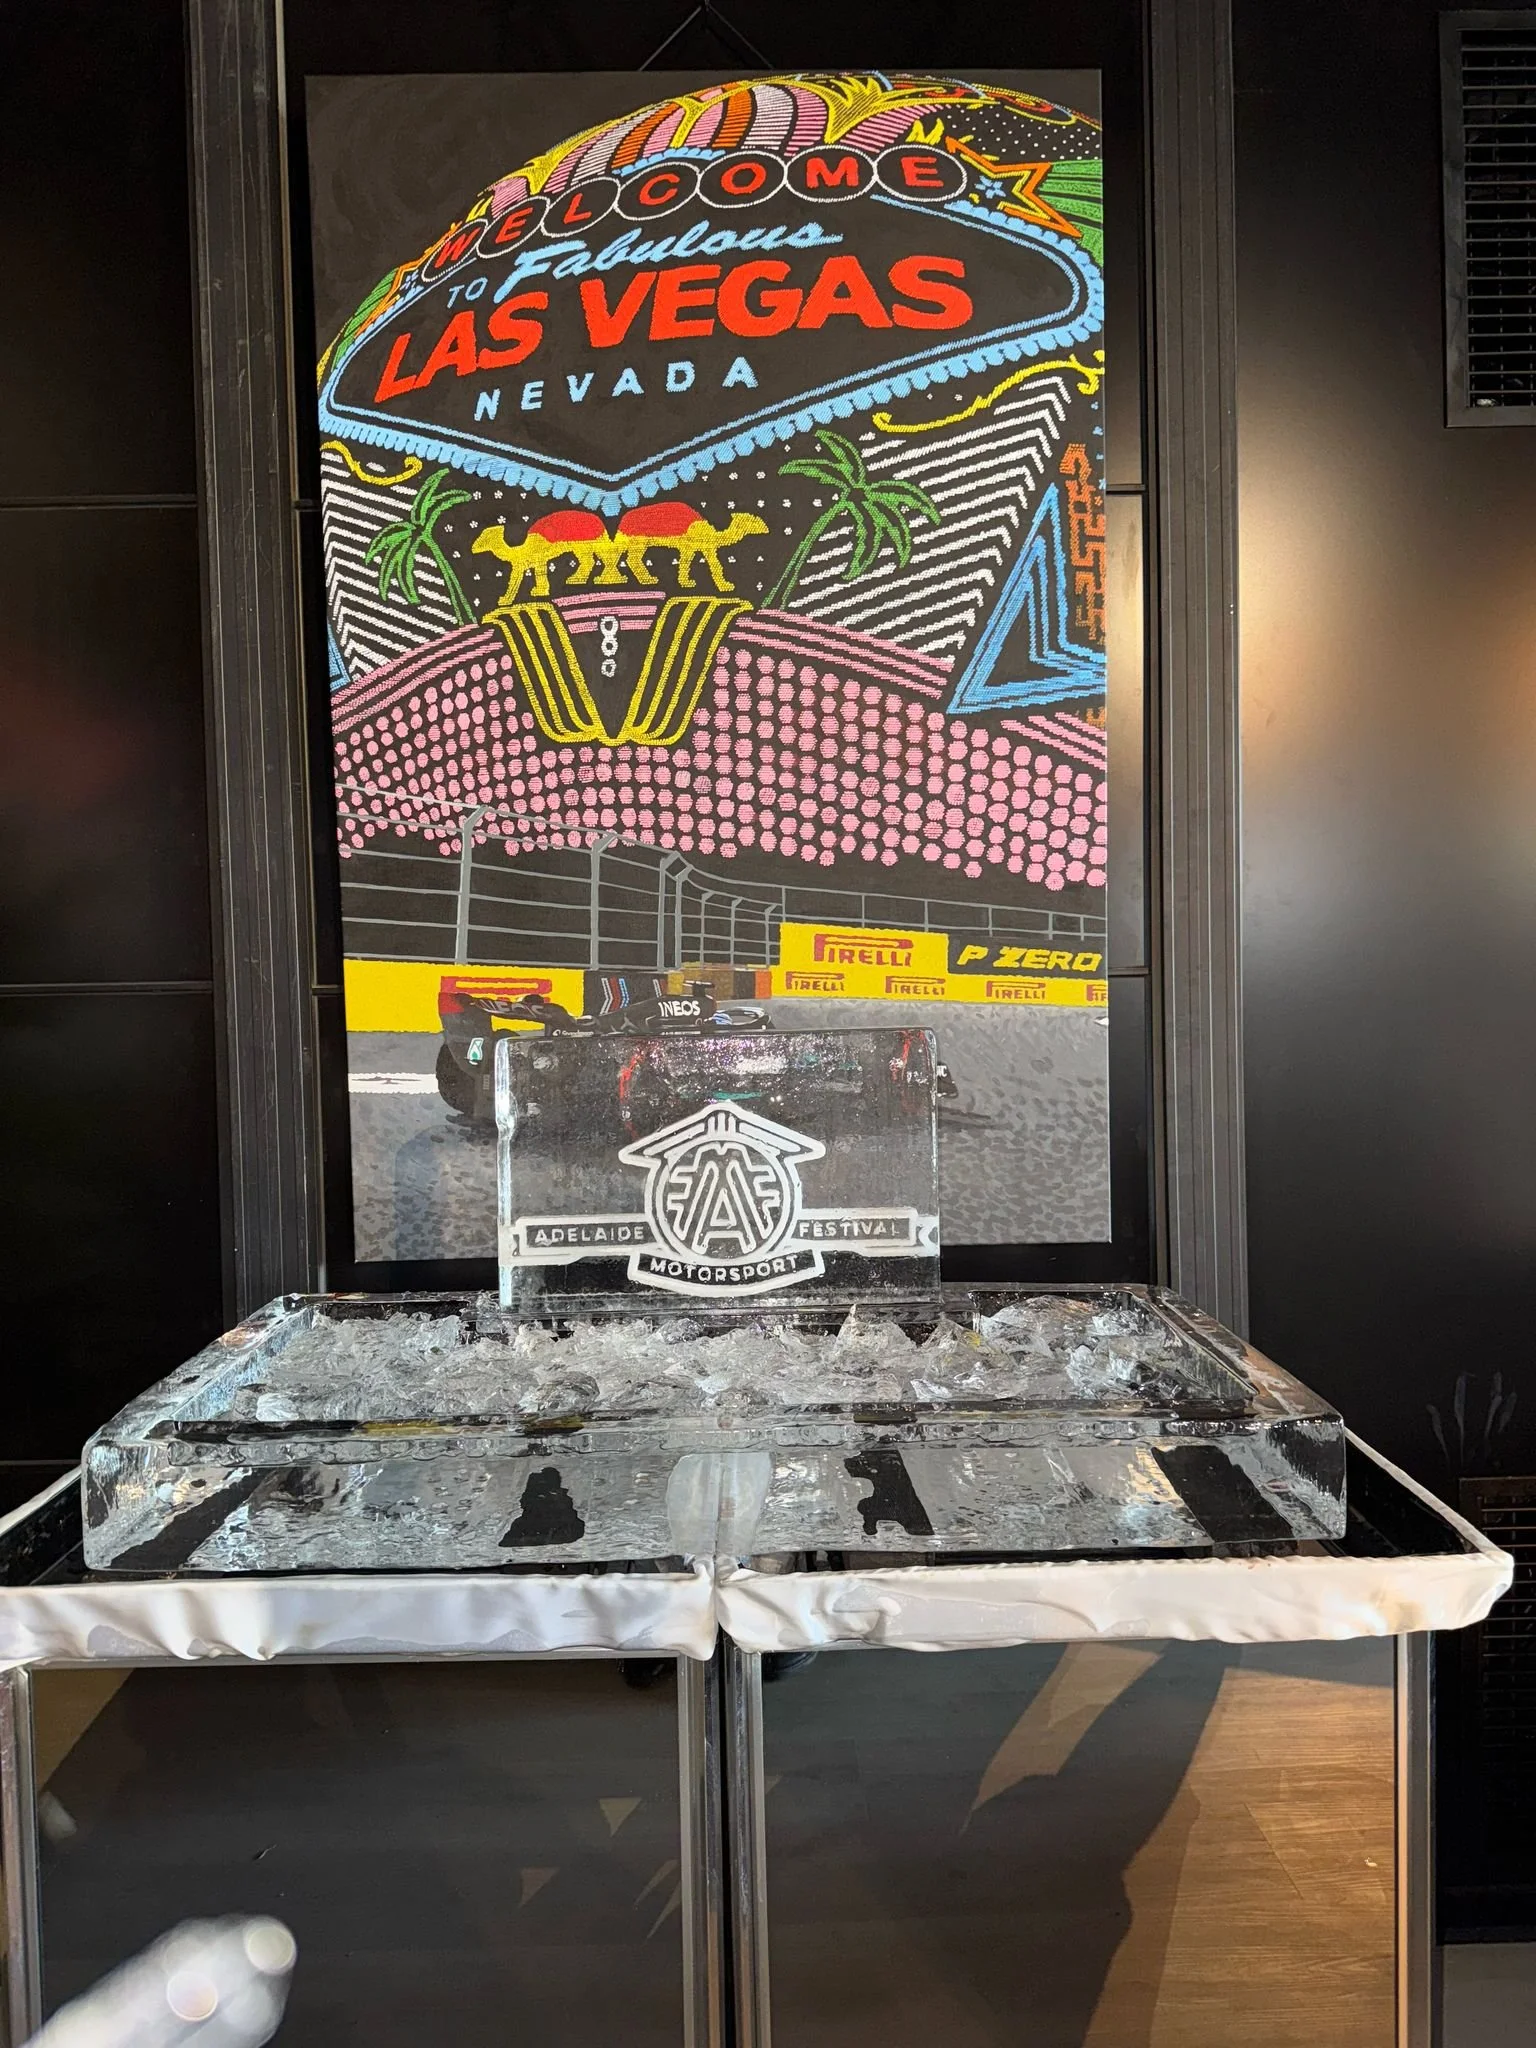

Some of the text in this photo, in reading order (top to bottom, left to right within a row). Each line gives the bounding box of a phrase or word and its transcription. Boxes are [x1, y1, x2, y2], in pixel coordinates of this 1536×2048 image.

[434, 155, 944, 269] WELCOME
[446, 222, 844, 309] TO Fabulous
[374, 254, 975, 404] LAS VEGAS
[474, 356, 758, 421] NEVADA
[814, 933, 914, 967] PIRELLI
[956, 944, 1103, 972] P ZERO
[785, 971, 845, 992] PIRELLI
[885, 975, 946, 996] PIRELLI
[986, 980, 1046, 1000] PIRELLI
[659, 1000, 701, 1018] INEOS
[534, 1225, 645, 1246] ADELAIDE
[799, 1218, 900, 1238] FESTIVAL
[649, 1254, 799, 1283] MOTORSPORT
